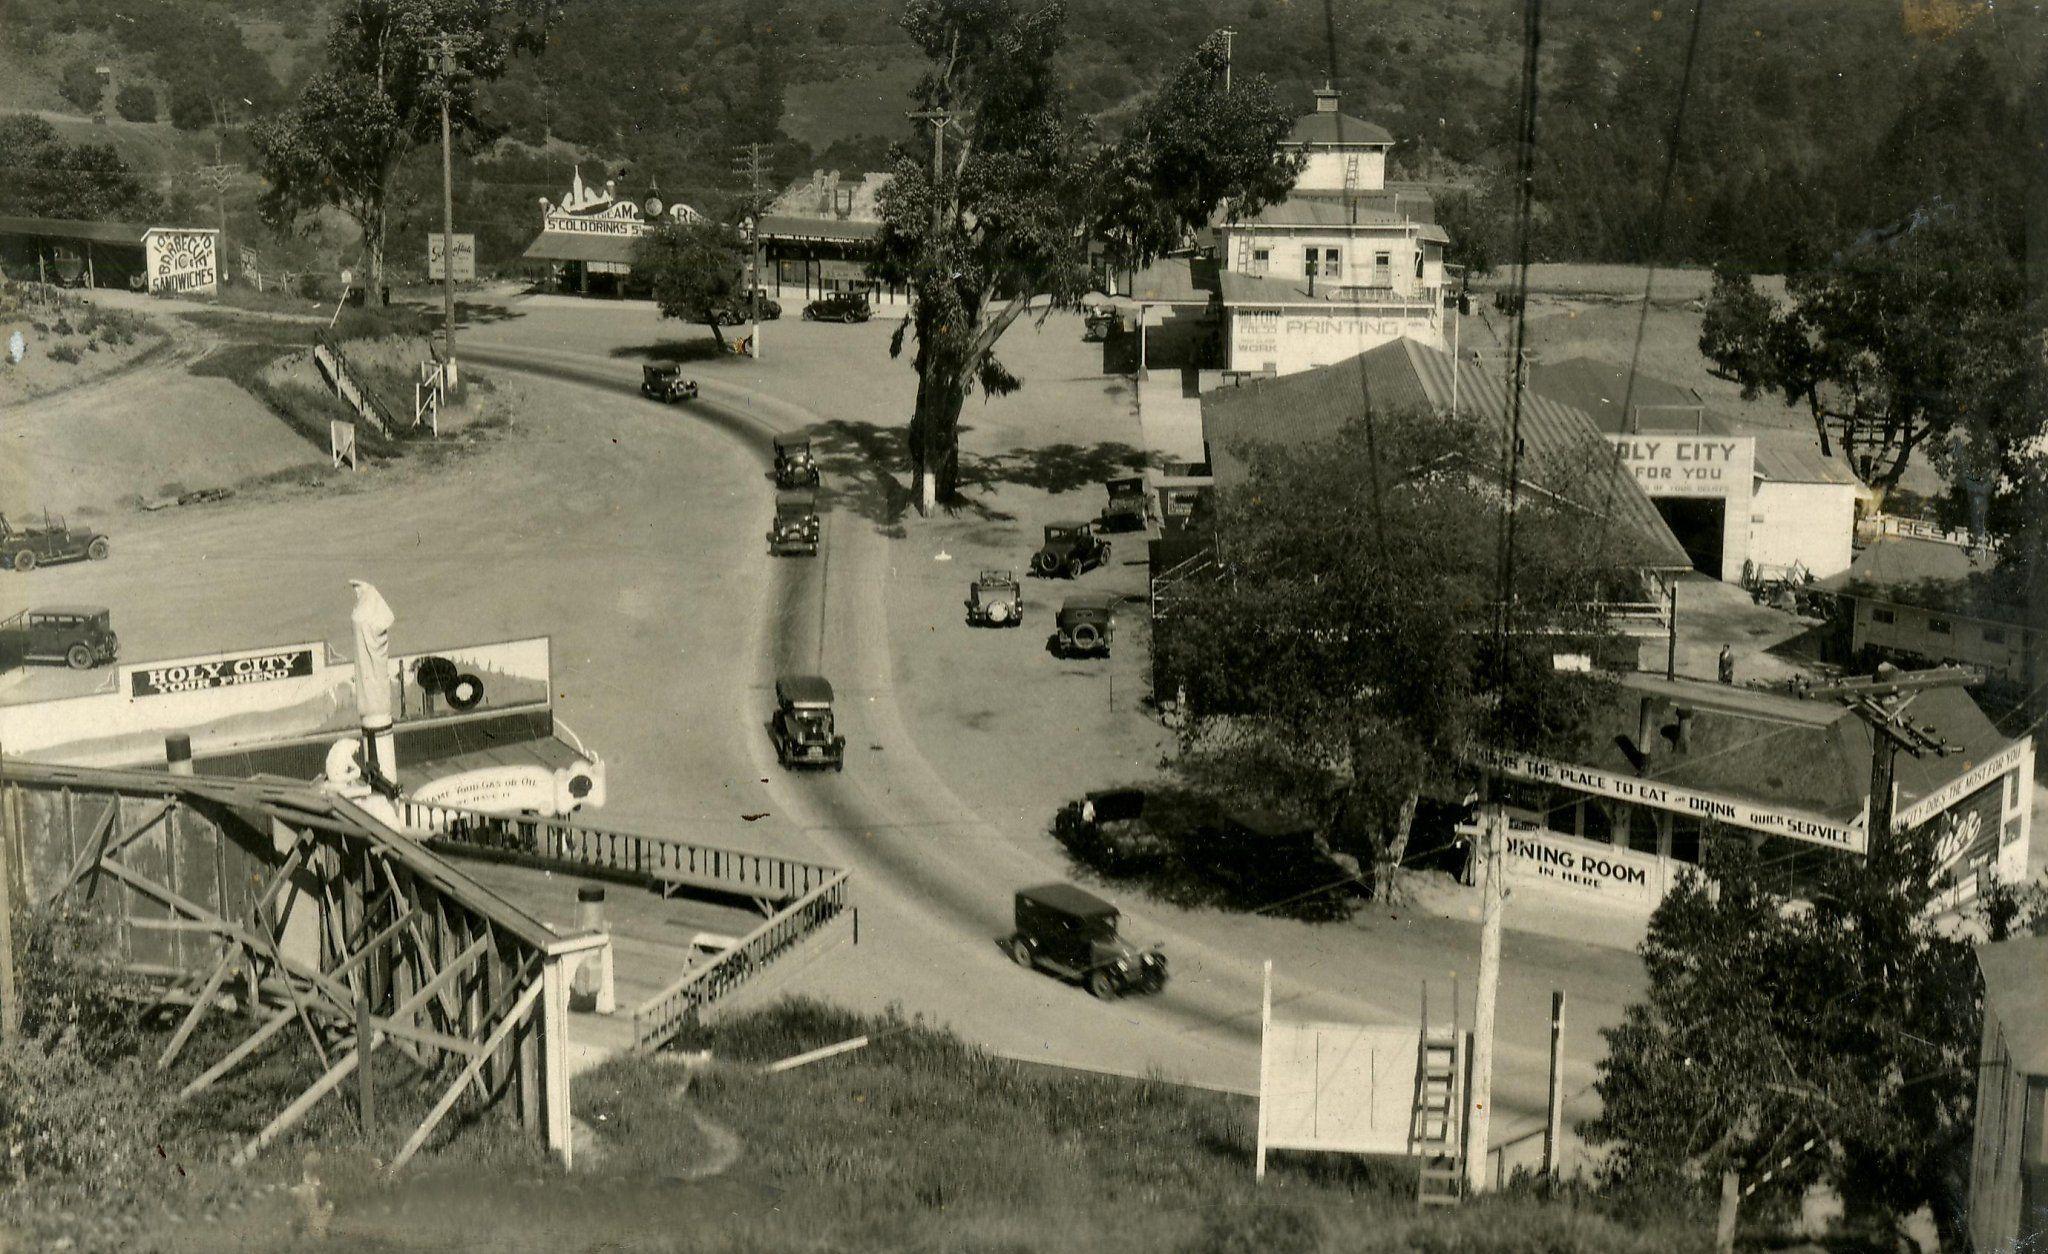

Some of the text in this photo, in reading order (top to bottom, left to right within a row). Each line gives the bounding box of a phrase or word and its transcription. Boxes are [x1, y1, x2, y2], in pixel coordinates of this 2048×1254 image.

[559, 220, 588, 232] COLD
[589, 221, 628, 235] DRINKS
[158, 233, 208, 275] BARBECUE
[152, 267, 214, 291] SANDWICHES
[1287, 320, 1399, 336] PRINTING
[1614, 442, 1737, 461] OLY CITY
[1635, 466, 1722, 480] FOR YOU
[148, 652, 300, 686] HOLY CITY
[154, 668, 290, 695] YOUR FRIEND
[1966, 767, 1986, 786] MOST
[1987, 756, 2004, 774] FOR
[2006, 745, 2021, 764] YOU
[1526, 759, 1553, 778] THE
[1559, 768, 1607, 790] PLACE
[1613, 780, 1634, 796] TO
[1639, 787, 1670, 803] EAT
[1689, 796, 1737, 819] DRINK
[1750, 812, 1785, 826] QUICK
[1787, 818, 1852, 845] SERVICE
[1539, 865, 1602, 890] IN HERE
[1581, 855, 1647, 887] ROOM
